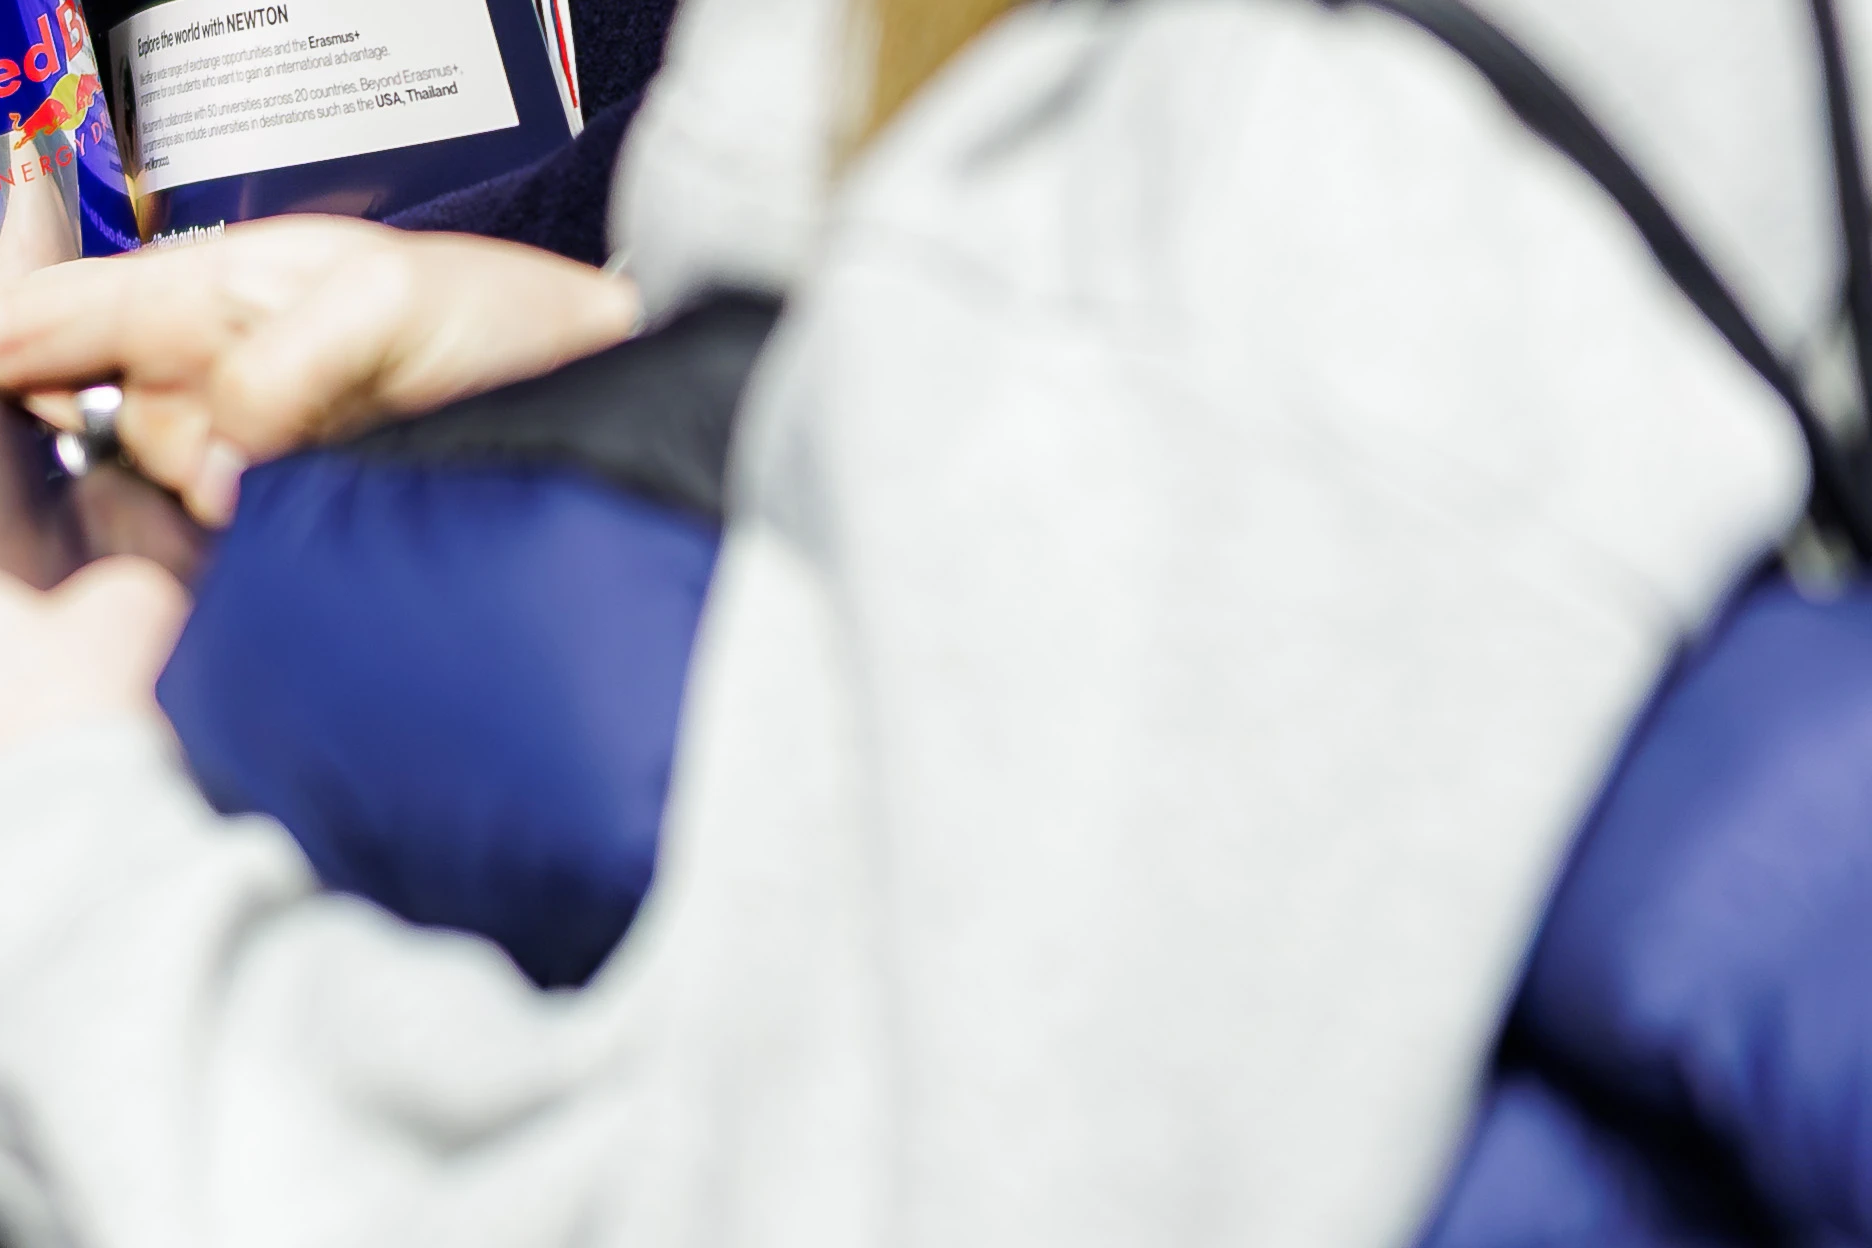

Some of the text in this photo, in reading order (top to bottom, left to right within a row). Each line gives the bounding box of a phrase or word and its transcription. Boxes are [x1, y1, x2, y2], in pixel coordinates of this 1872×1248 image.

[160, 32, 174, 48] the
[174, 22, 200, 44] world
[200, 18, 224, 37] with
[226, 5, 288, 32] NEWTON
[308, 33, 359, 48] Erasmus+
[294, 88, 308, 102] 20
[360, 74, 401, 93] Beyond
[374, 82, 457, 107] USA, Thailand
